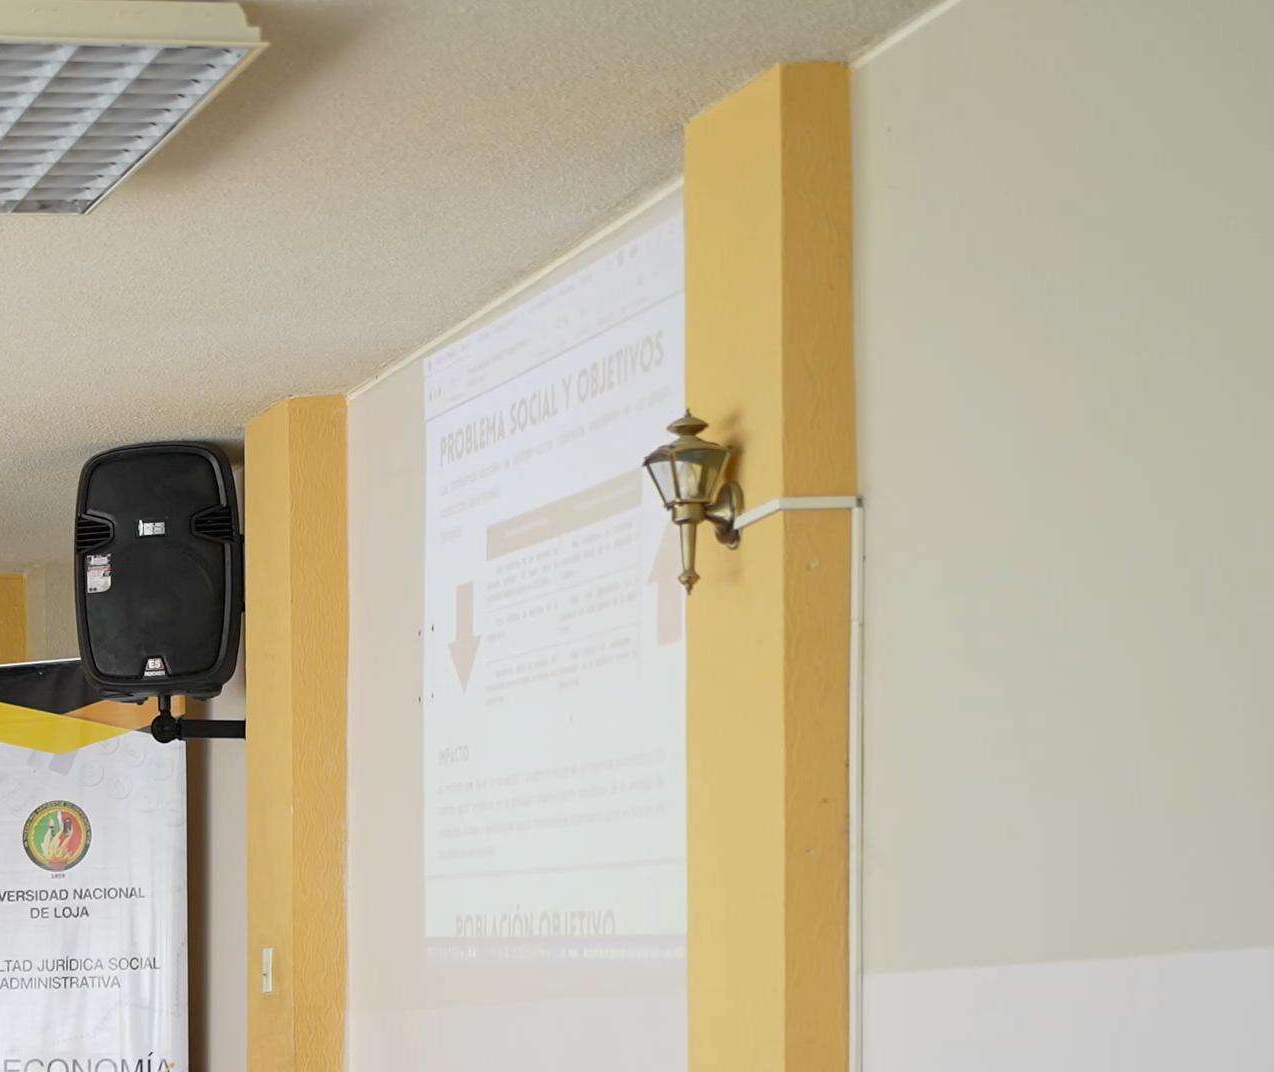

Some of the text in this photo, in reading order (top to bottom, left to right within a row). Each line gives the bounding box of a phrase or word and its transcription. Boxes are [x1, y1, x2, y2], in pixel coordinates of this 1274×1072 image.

[440, 411, 505, 467] PROBLEMA
[509, 387, 557, 435] SOCIAL
[562, 374, 572, 410] Y
[577, 330, 665, 402] OBJETIVOS
[73, 887, 145, 900] NACIONAL
[30, 906, 89, 919] DE LOJA
[37, 955, 103, 972] JURÍDICA
[108, 957, 161, 970] SOCIAL
